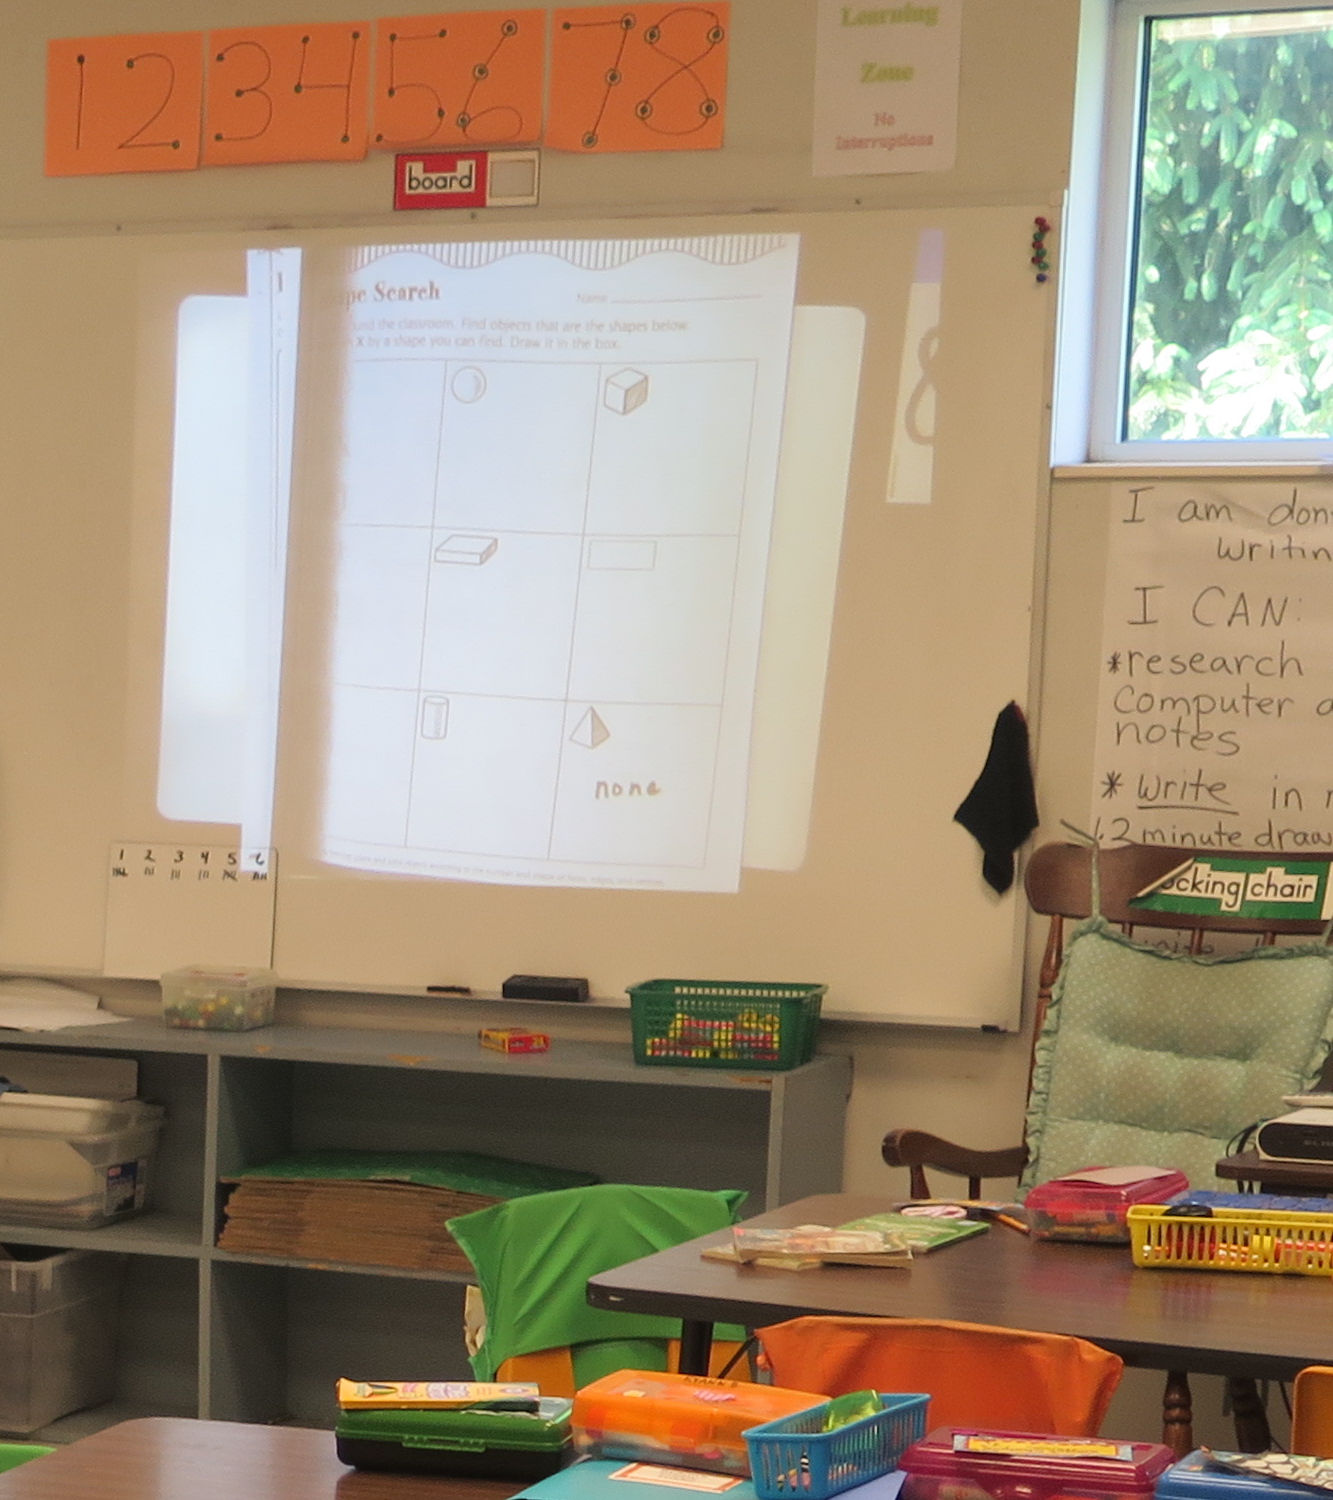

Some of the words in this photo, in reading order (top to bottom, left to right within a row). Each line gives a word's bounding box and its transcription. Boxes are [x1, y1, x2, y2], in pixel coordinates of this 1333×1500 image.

[408, 163, 473, 191] board
[374, 281, 440, 302] Search
[1123, 487, 1155, 523] I
[1178, 497, 1233, 523] am
[1267, 488, 1333, 528] don
[1217, 535, 1333, 562] writin
[1128, 585, 1164, 626] I
[1129, 640, 1304, 678] research
[1115, 715, 1241, 757] notes
[595, 778, 661, 800] none
[1272, 776, 1303, 812] in
[1142, 822, 1243, 848] minute
[1161, 866, 1241, 909] ocking
[1251, 869, 1314, 900] chair
